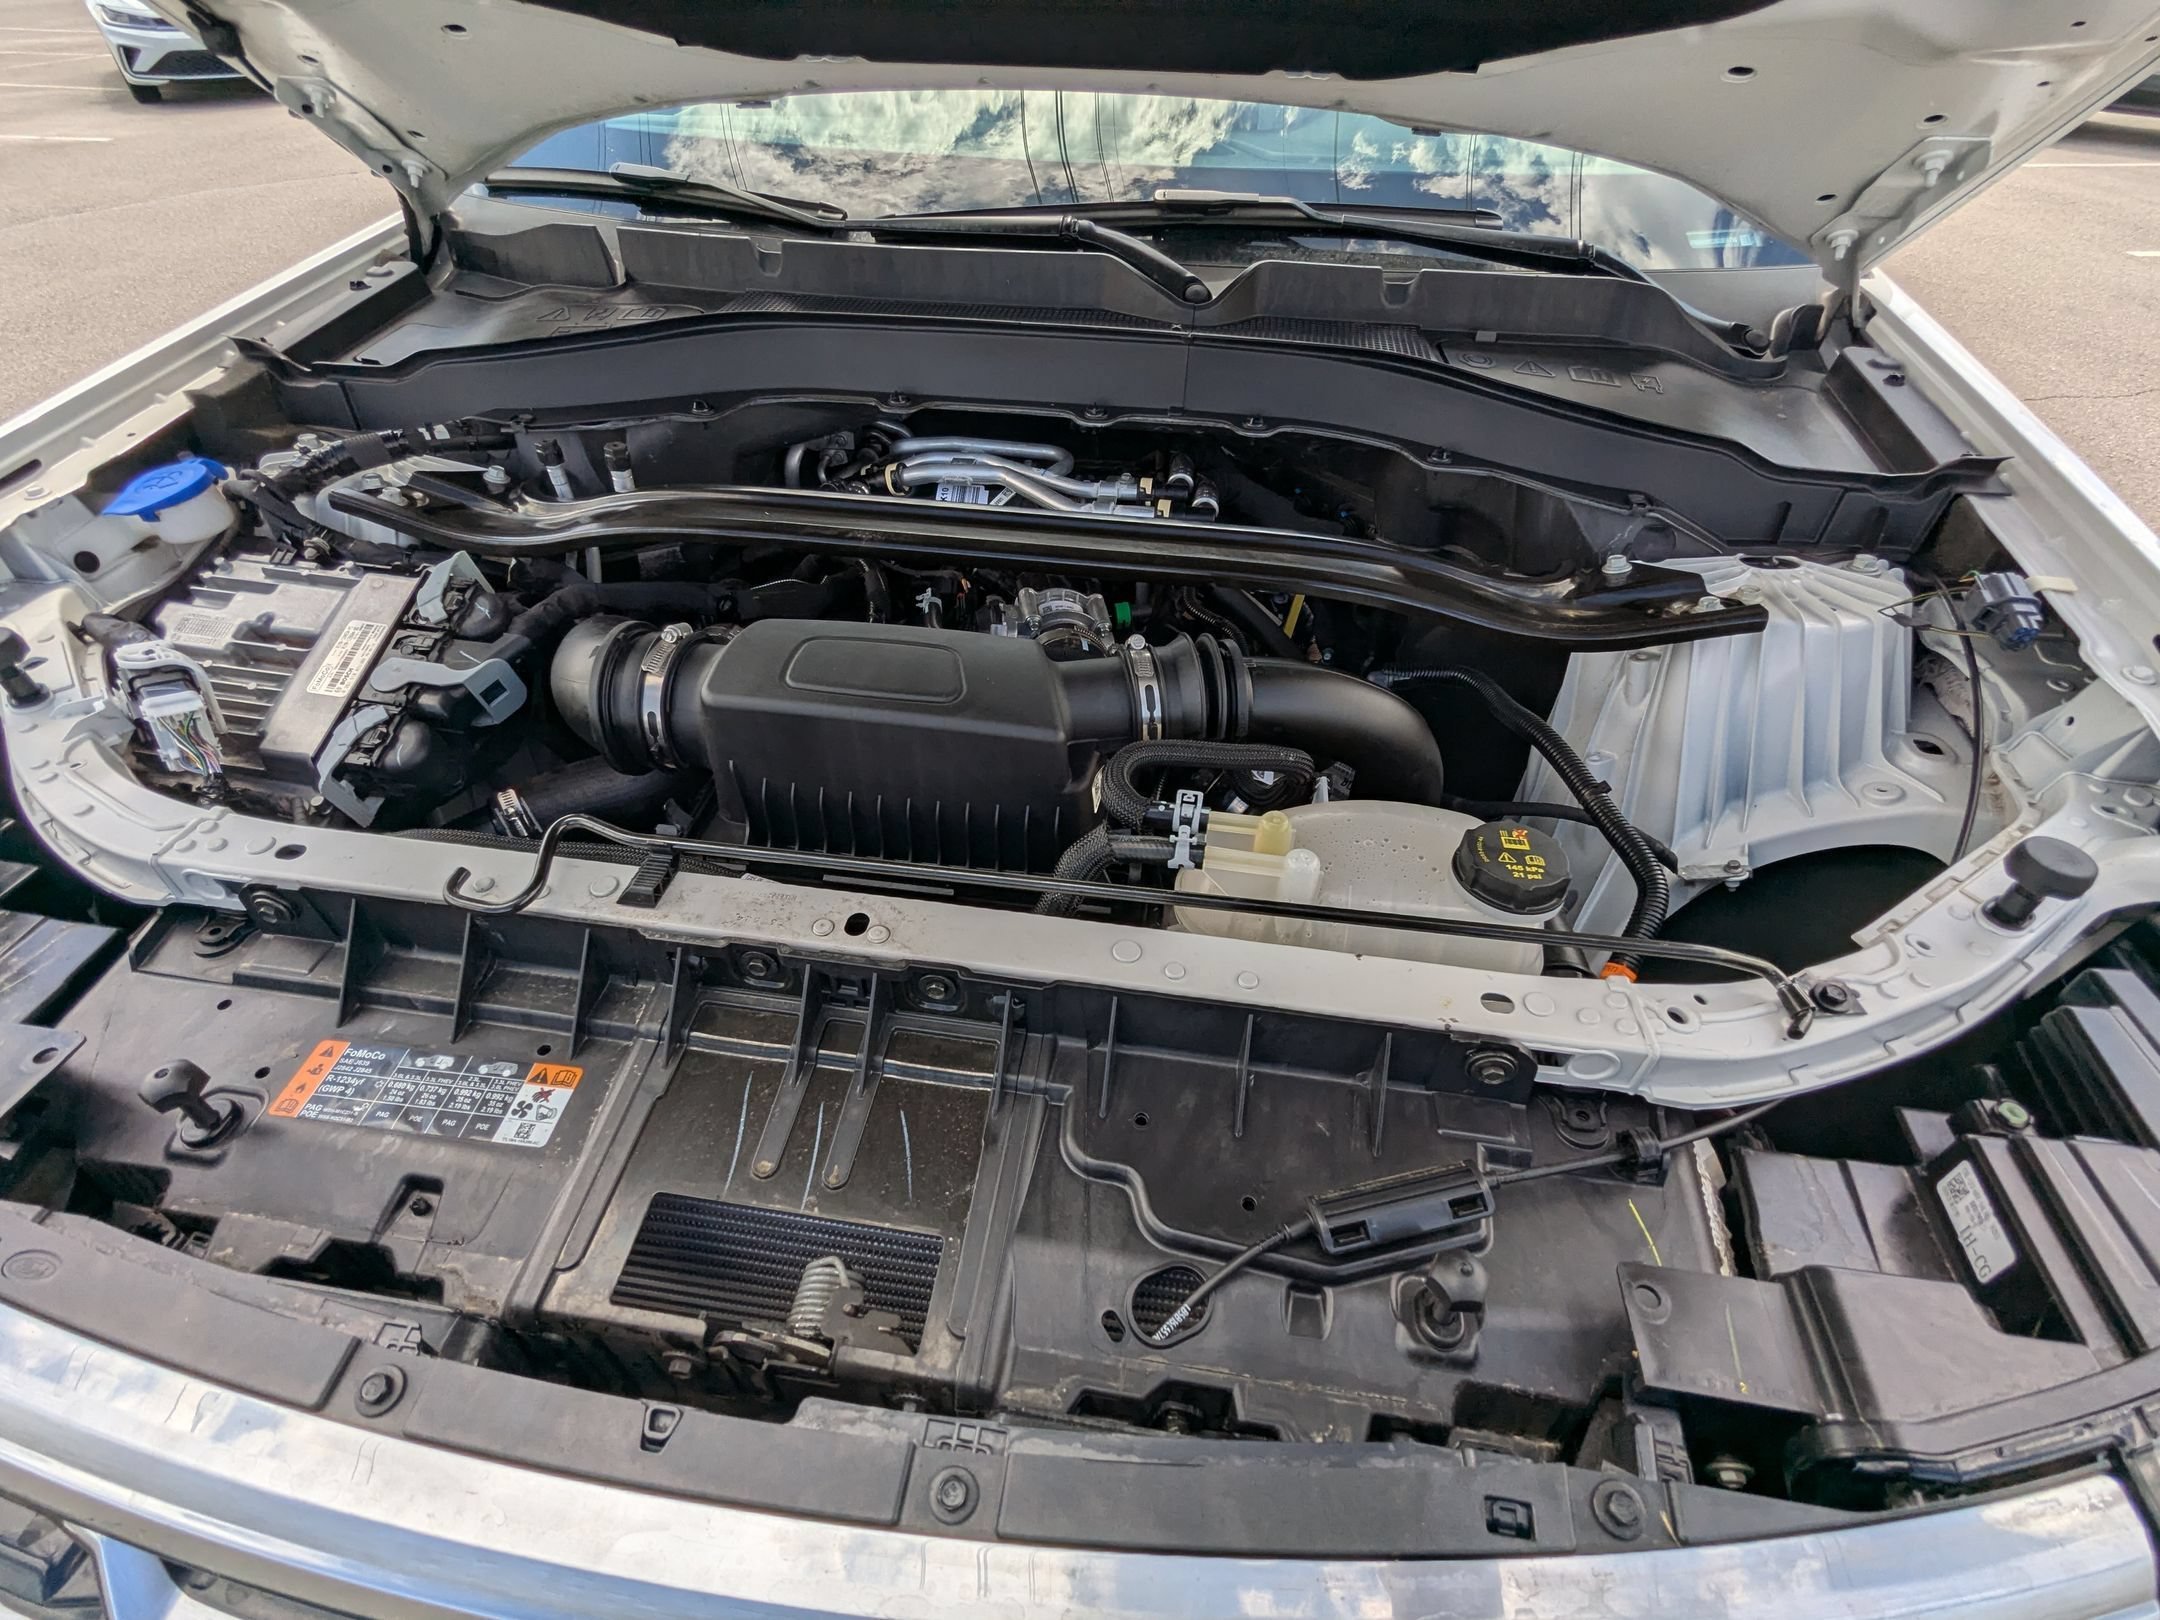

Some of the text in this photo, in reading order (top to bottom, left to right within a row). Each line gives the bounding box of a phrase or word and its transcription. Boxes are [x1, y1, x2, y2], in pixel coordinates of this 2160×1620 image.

[340, 667, 354, 685] BOSCH
[344, 1048, 387, 1060] FoMoCo
[339, 1057, 354, 1065] SAE
[326, 1074, 367, 1087] R-1234yf
[318, 1084, 355, 1097] (GWP 4)
[406, 1083, 416, 1092] kg
[420, 1085, 447, 1096] 0.737 kg
[453, 1088, 482, 1100] 0.992 kg
[485, 1092, 514, 1104] 0.992 kg
[304, 1103, 323, 1111] PAG
[299, 1109, 319, 1118] POE
[441, 1118, 457, 1127] PAG
[475, 1122, 491, 1131] POE
